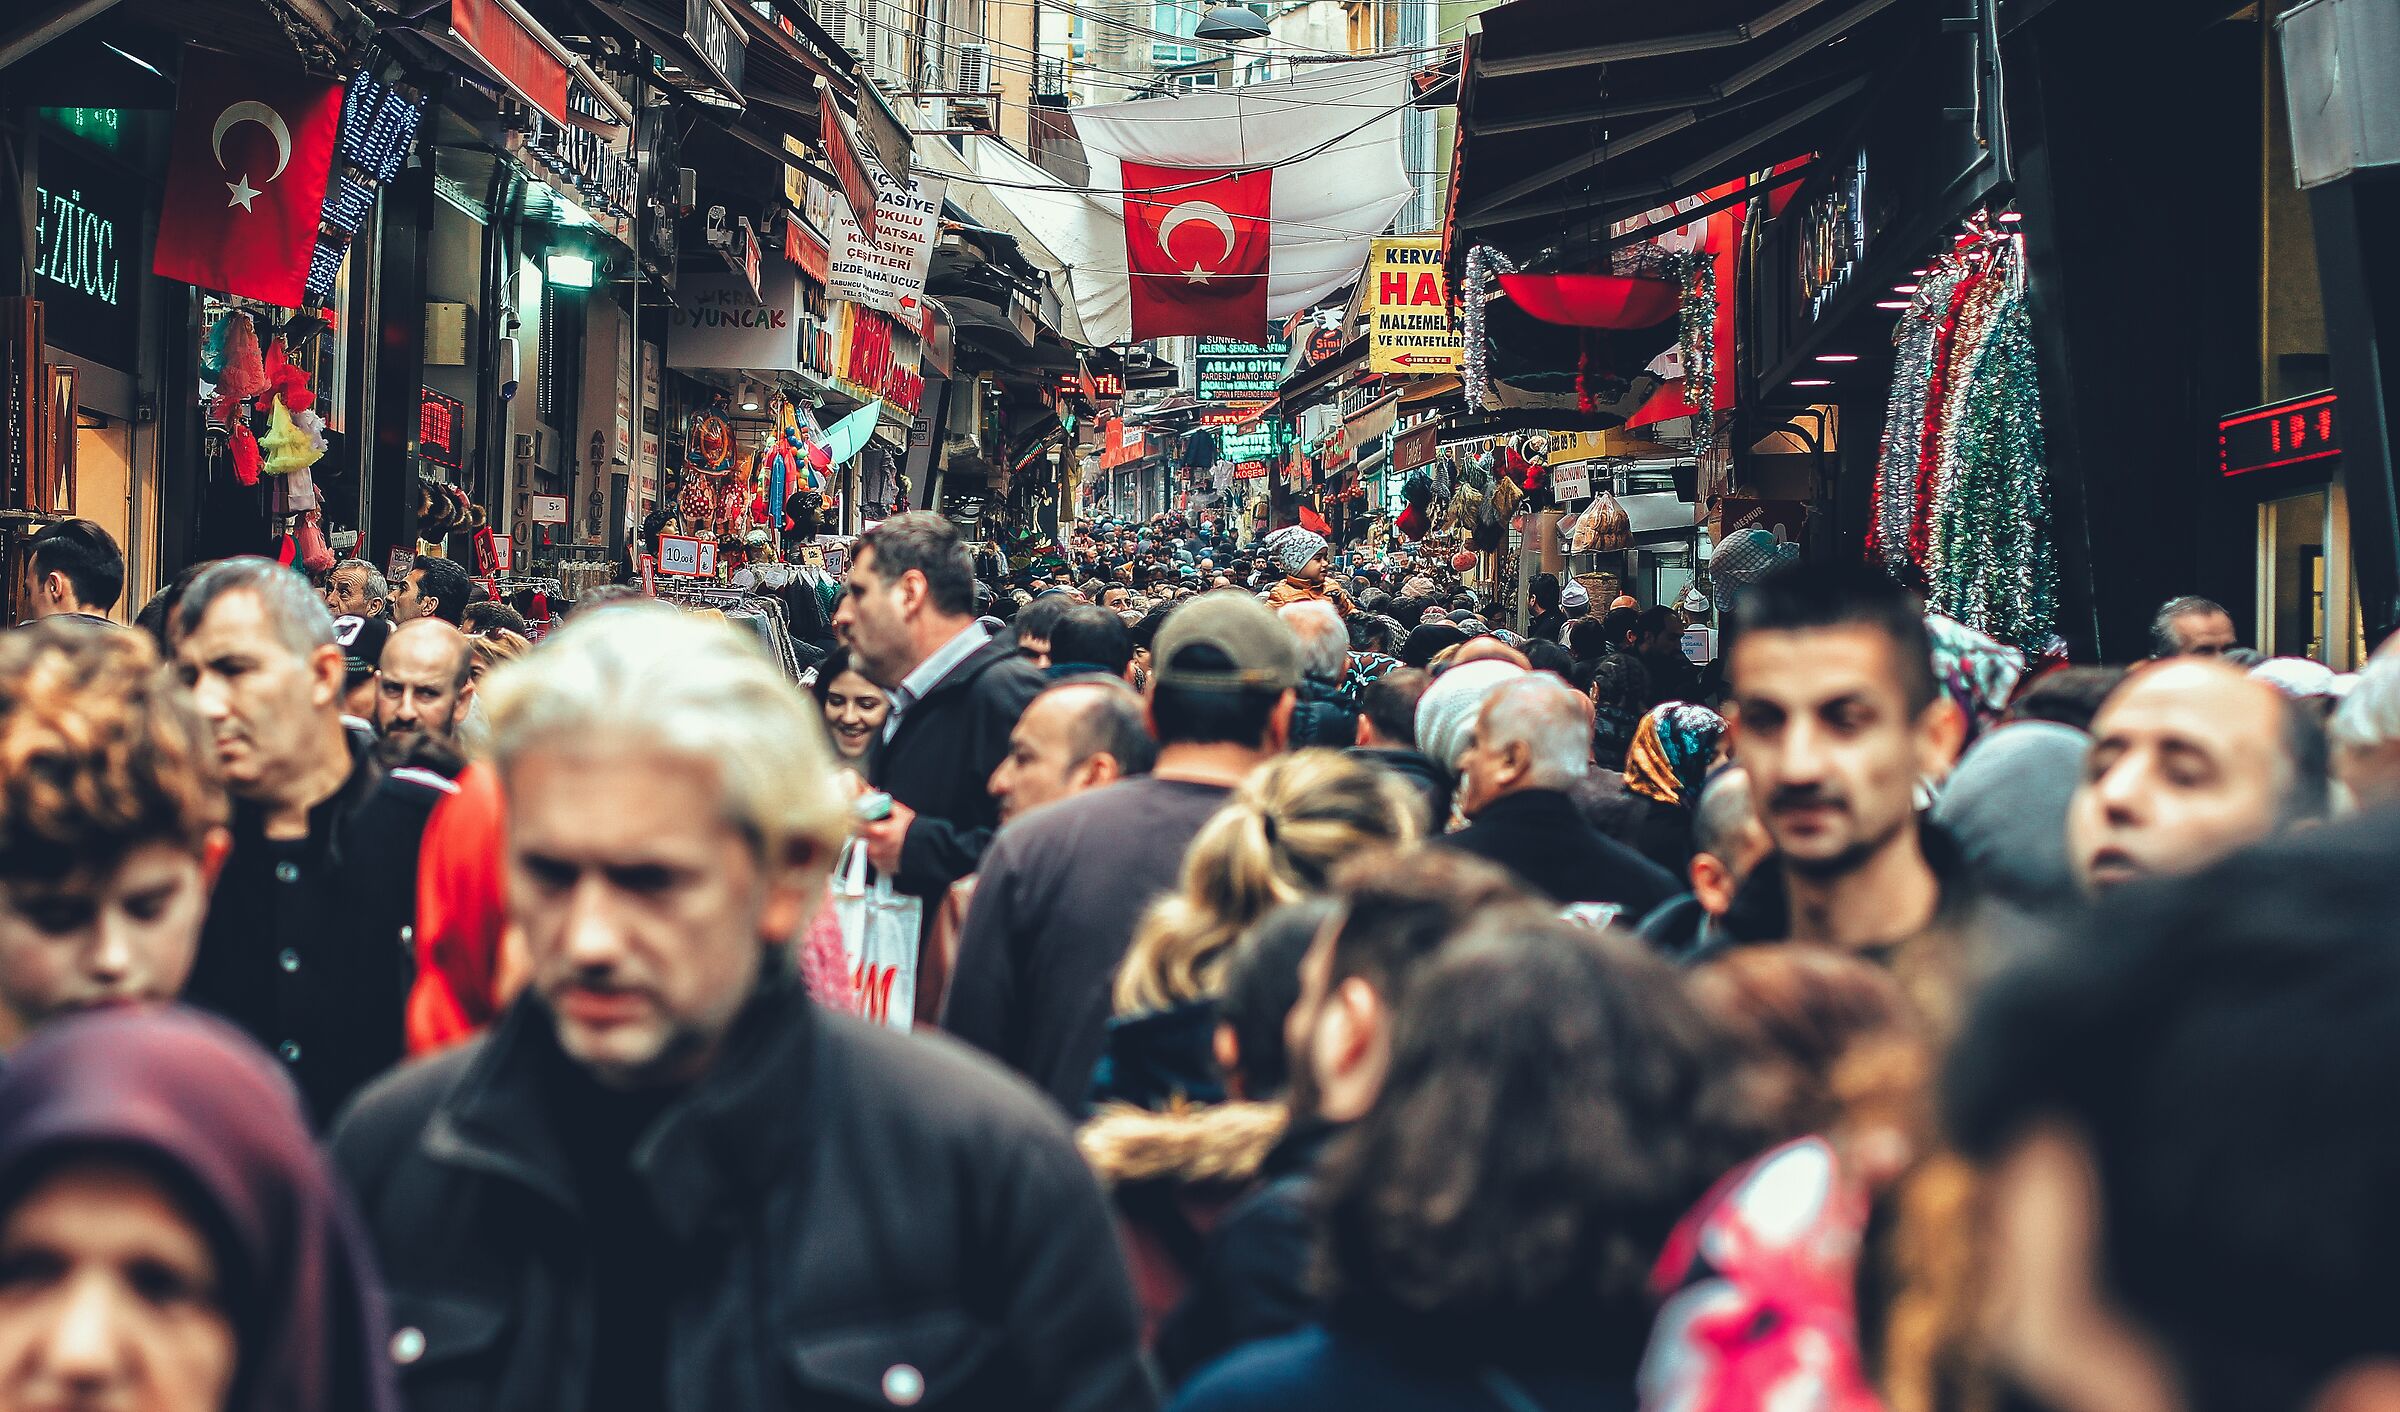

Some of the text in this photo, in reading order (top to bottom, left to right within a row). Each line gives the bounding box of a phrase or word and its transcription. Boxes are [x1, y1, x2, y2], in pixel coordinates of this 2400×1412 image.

[875, 208, 923, 226] OKULU
[841, 218, 926, 244] ve NATSAL
[847, 247, 911, 271] ÇEŞİTLERİ
[1386, 248, 1442, 265] KERVA
[830, 279, 861, 289] SABUNCU
[832, 262, 863, 275] BİZDE
[891, 277, 920, 290] UCUZ
[672, 308, 786, 331] OYUNCAK
[1380, 314, 1464, 333] MALZEMELRİ
[1379, 335, 1392, 346] VE
[1206, 359, 1281, 373] ASLAN GİYİM
[1236, 373, 1259, 381] MANTO
[1237, 461, 1262, 471] MODA
[1732, 506, 1764, 531] MEŞHUR
